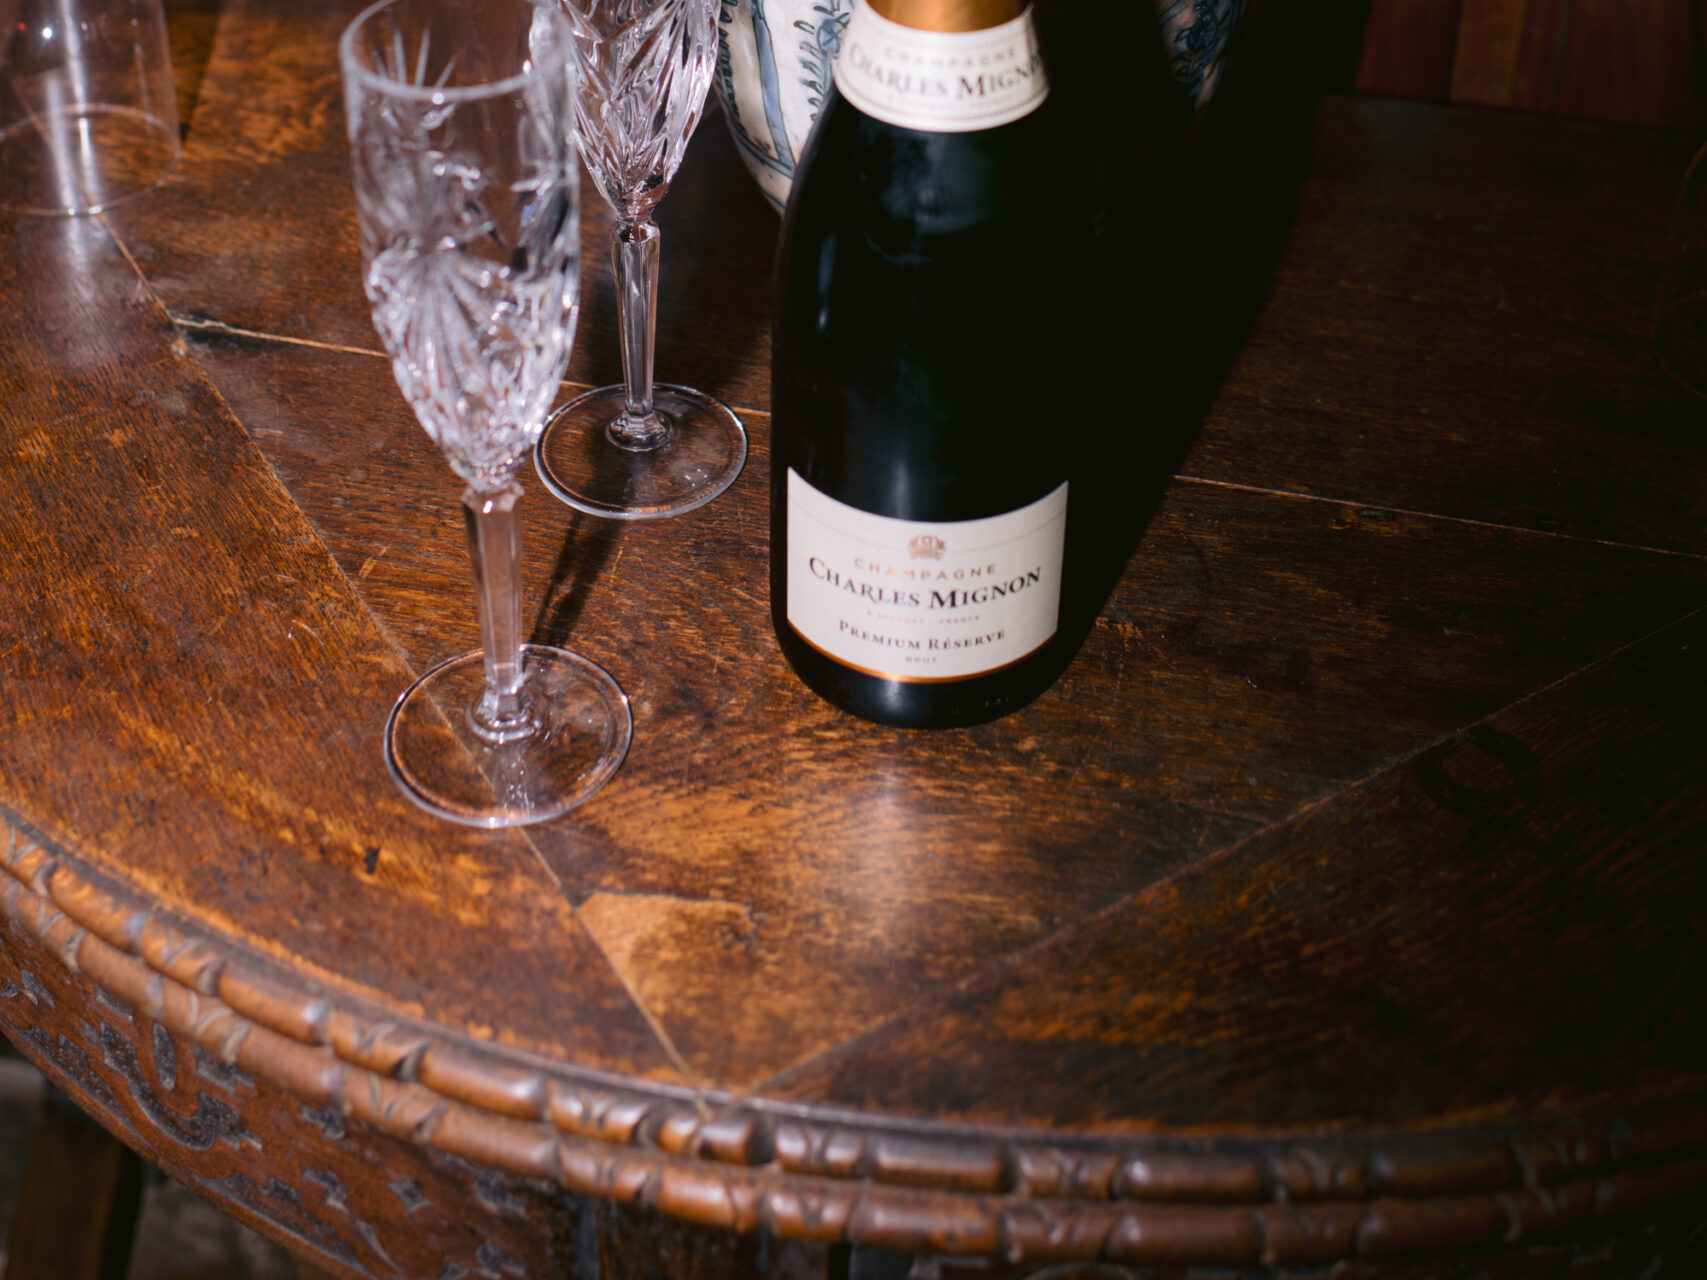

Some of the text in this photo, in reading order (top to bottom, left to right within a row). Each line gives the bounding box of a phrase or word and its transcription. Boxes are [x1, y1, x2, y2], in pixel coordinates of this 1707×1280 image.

[850, 42, 948, 96] CHARLES
[884, 45, 1016, 68] CHAMPAGNE
[808, 556, 1042, 610] CHARLES MIGNON
[854, 557, 997, 581] CHAMPAGNE
[839, 619, 1005, 650] PREMIUM RÉSERVE
